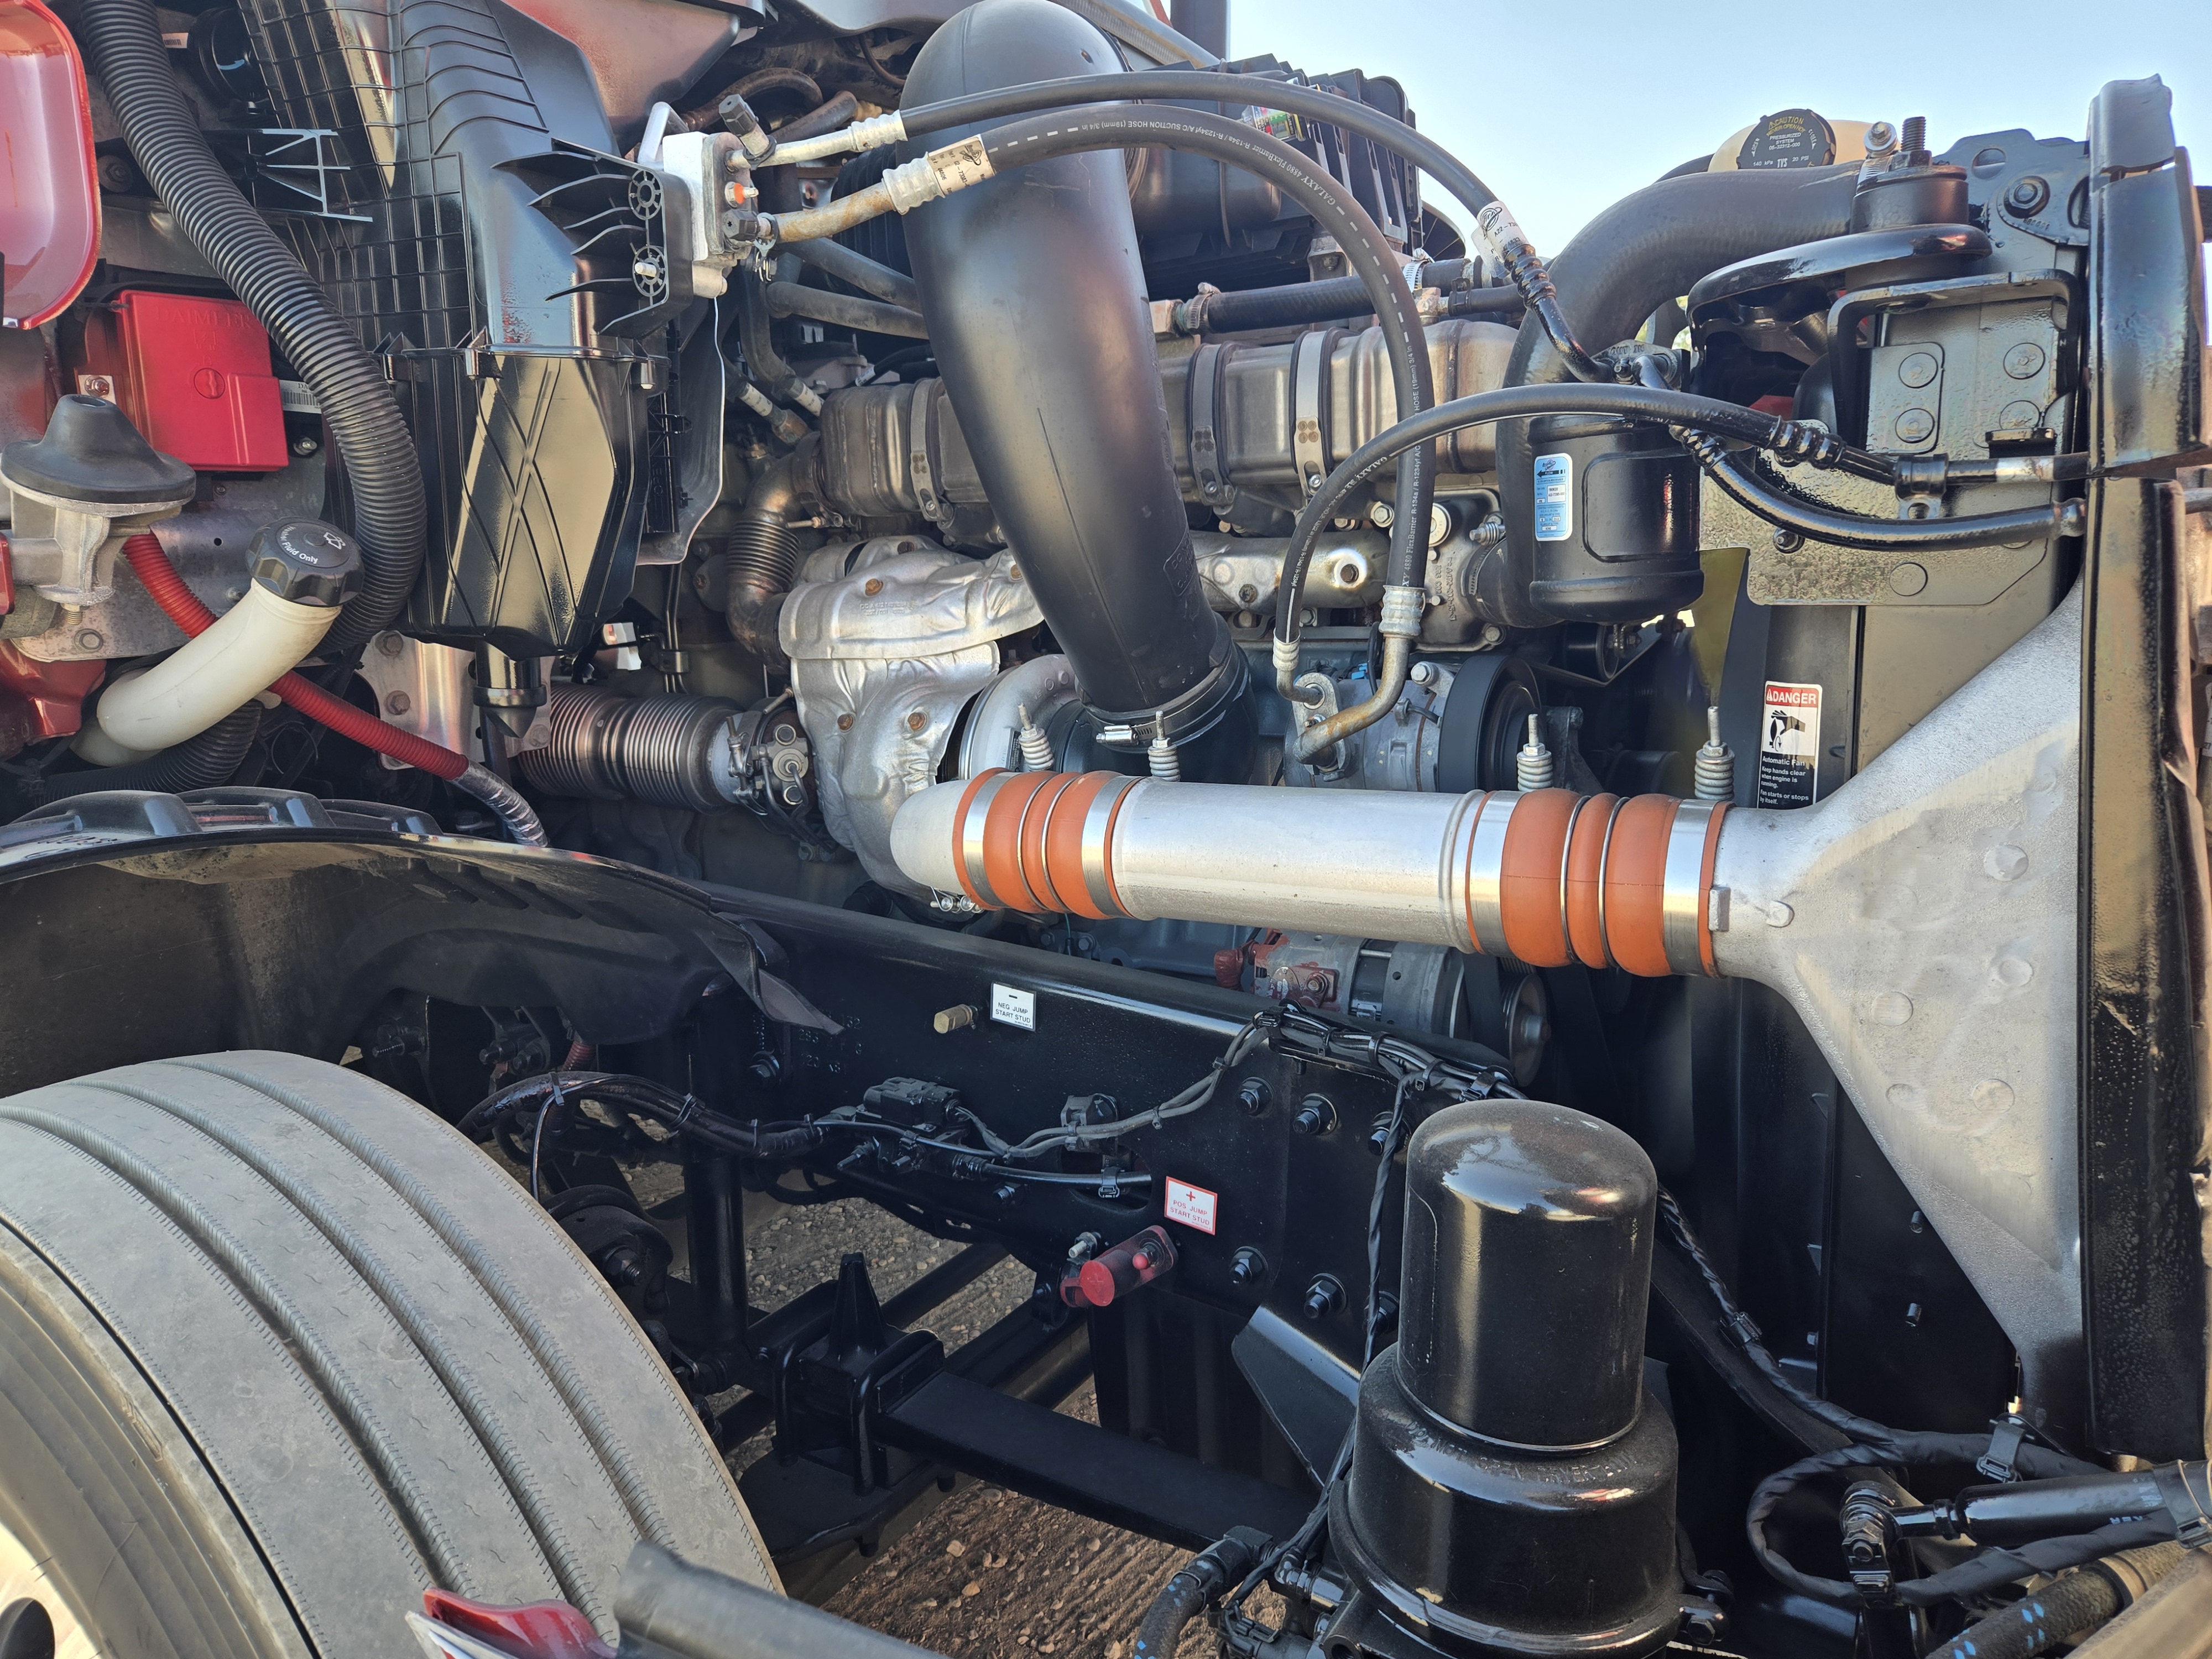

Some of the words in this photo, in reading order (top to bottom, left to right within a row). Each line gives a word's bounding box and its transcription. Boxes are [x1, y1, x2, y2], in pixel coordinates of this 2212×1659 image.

[1101, 120, 1126, 129] (19mm)
[1149, 121, 1181, 130] SUCTION
[1775, 116, 1804, 124] CAUTION
[1182, 123, 1195, 133] A/C
[1195, 127, 1223, 140] R-1234yf
[1766, 126, 1783, 137] NEVER
[1228, 136, 1250, 149] R-134a
[1769, 142, 1801, 150] 05-32312-000
[1251, 144, 1288, 169] FlexBarrier
[1777, 158, 1788, 168] TVS
[1286, 164, 1302, 178] 4880
[1300, 175, 1336, 205] GALAXY
[1410, 364, 1419, 389] (19mm)
[1356, 457, 1387, 481] GALAXY
[1413, 458, 1421, 487] R-1234yf
[1406, 517, 1417, 554] FlexBarrier
[282, 542, 299, 555] Fluid
[299, 553, 319, 564] Only
[1404, 555, 1412, 572] 4880
[1773, 691, 1817, 705] DANGER
[1762, 756, 1790, 765] Automatic
[1791, 758, 1805, 766] Fan
[1772, 767, 1788, 775] hands
[995, 1009, 1013, 1018] START
[1015, 1014, 1031, 1023] STUD
[1173, 1200, 1187, 1209] POS
[1190, 1206, 1208, 1215] JUMP
[1170, 1207, 1191, 1218] START
[1192, 1215, 1209, 1225] STUD
